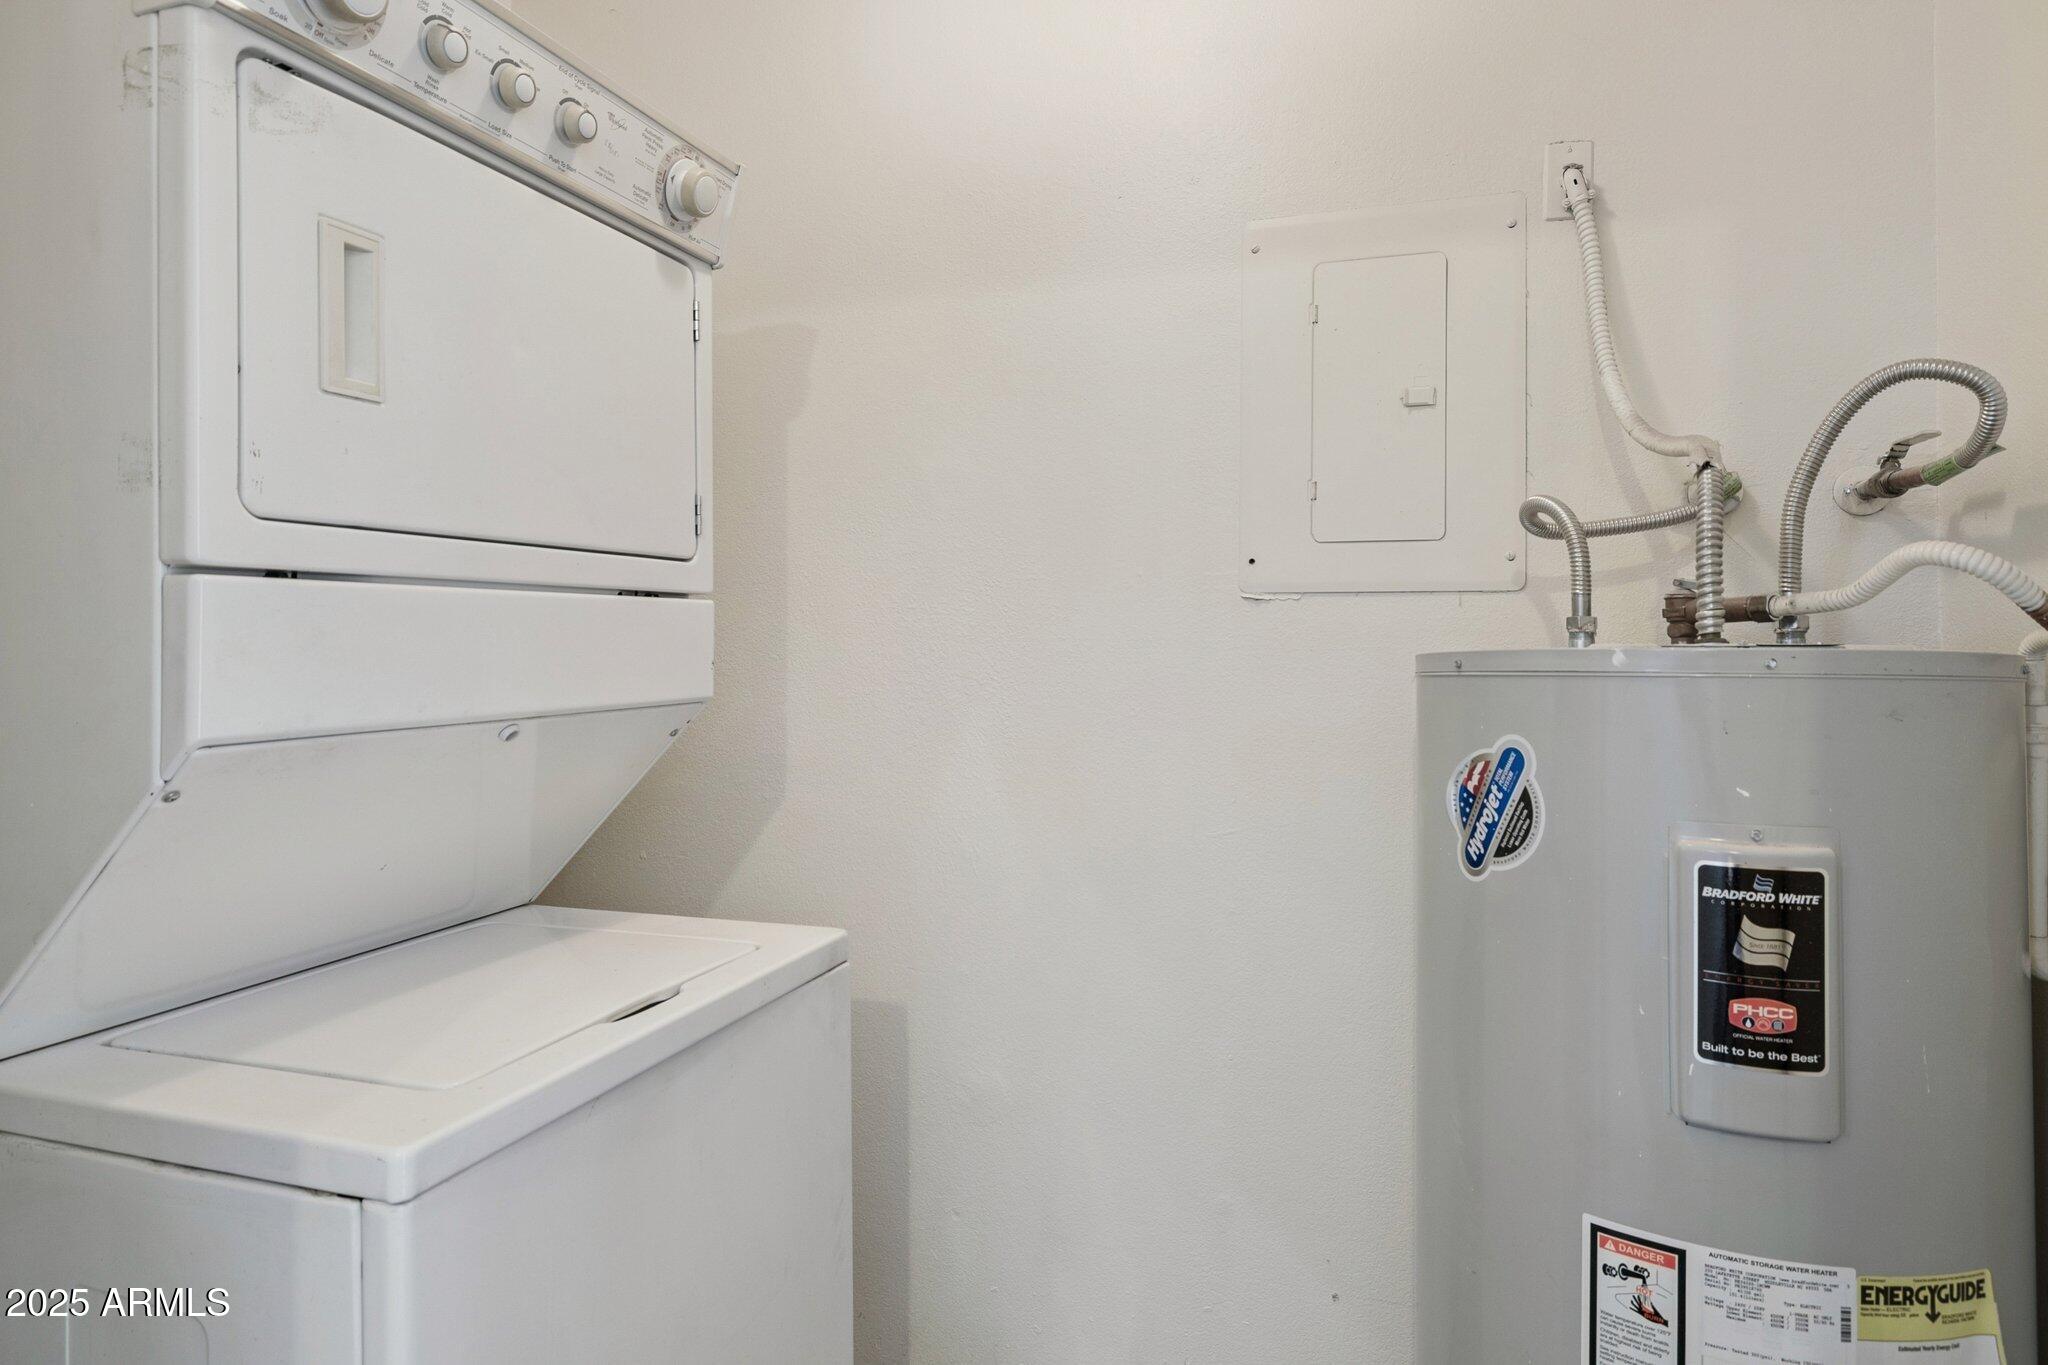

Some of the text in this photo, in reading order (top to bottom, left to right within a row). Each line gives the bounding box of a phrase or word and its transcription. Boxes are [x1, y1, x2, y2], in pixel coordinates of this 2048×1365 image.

[368, 49, 395, 68] Delicate
[413, 80, 448, 104] Temperature
[1467, 783, 1504, 862] Hydrojet
[1702, 886, 1820, 905] BRADFORD WHITE
[1711, 899, 1812, 911] CORPORATION
[1703, 972, 1766, 985] ENERGY
[1733, 1002, 1794, 1020] PHCC
[1732, 1032, 1793, 1044] OFFICIAL WATER HEATER
[1702, 1042, 1818, 1063] Built to be the Best
[1618, 1243, 1664, 1264] DANGER
[1709, 1252, 1748, 1265] AUTOMATIC
[1751, 1260, 1784, 1271] STORAGE
[1785, 1266, 1809, 1274] WATER
[1635, 1286, 1653, 1297] HOT
[1860, 1279, 1986, 1307] ENERGYGUIDE
[1644, 1312, 1664, 1324] BURN
